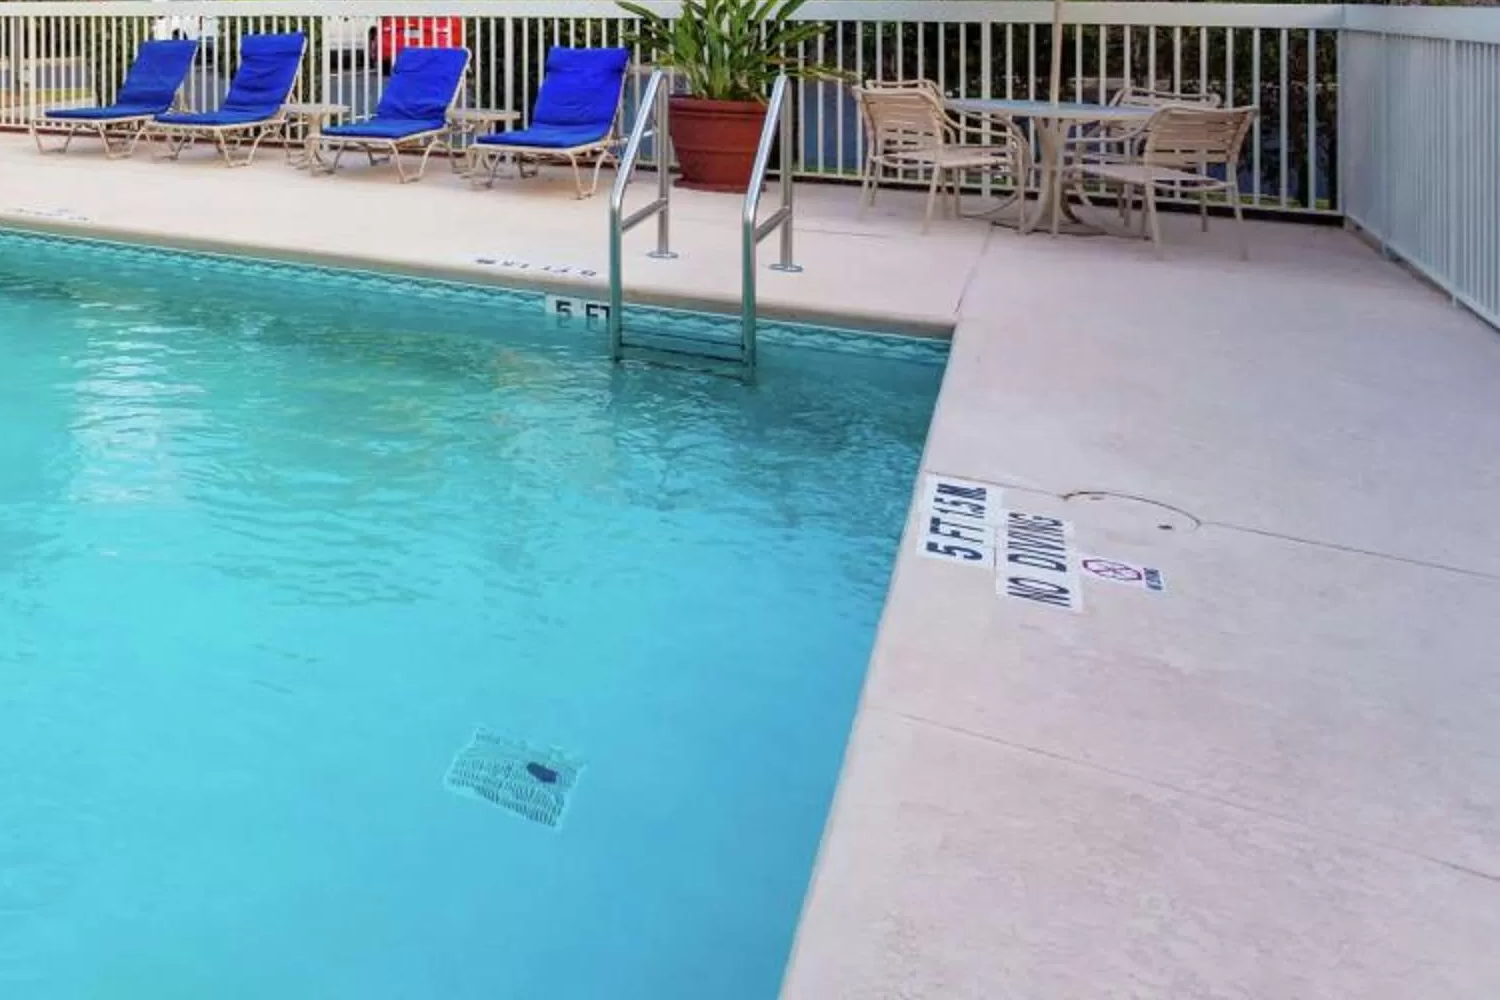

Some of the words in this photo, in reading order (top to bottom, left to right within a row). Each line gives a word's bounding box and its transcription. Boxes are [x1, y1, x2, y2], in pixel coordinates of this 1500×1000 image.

[556, 299, 572, 319] 5
[929, 516, 985, 543] FT
[1007, 512, 1067, 573] DIVING
[926, 541, 983, 560] 5
[1007, 576, 1071, 607] NO
